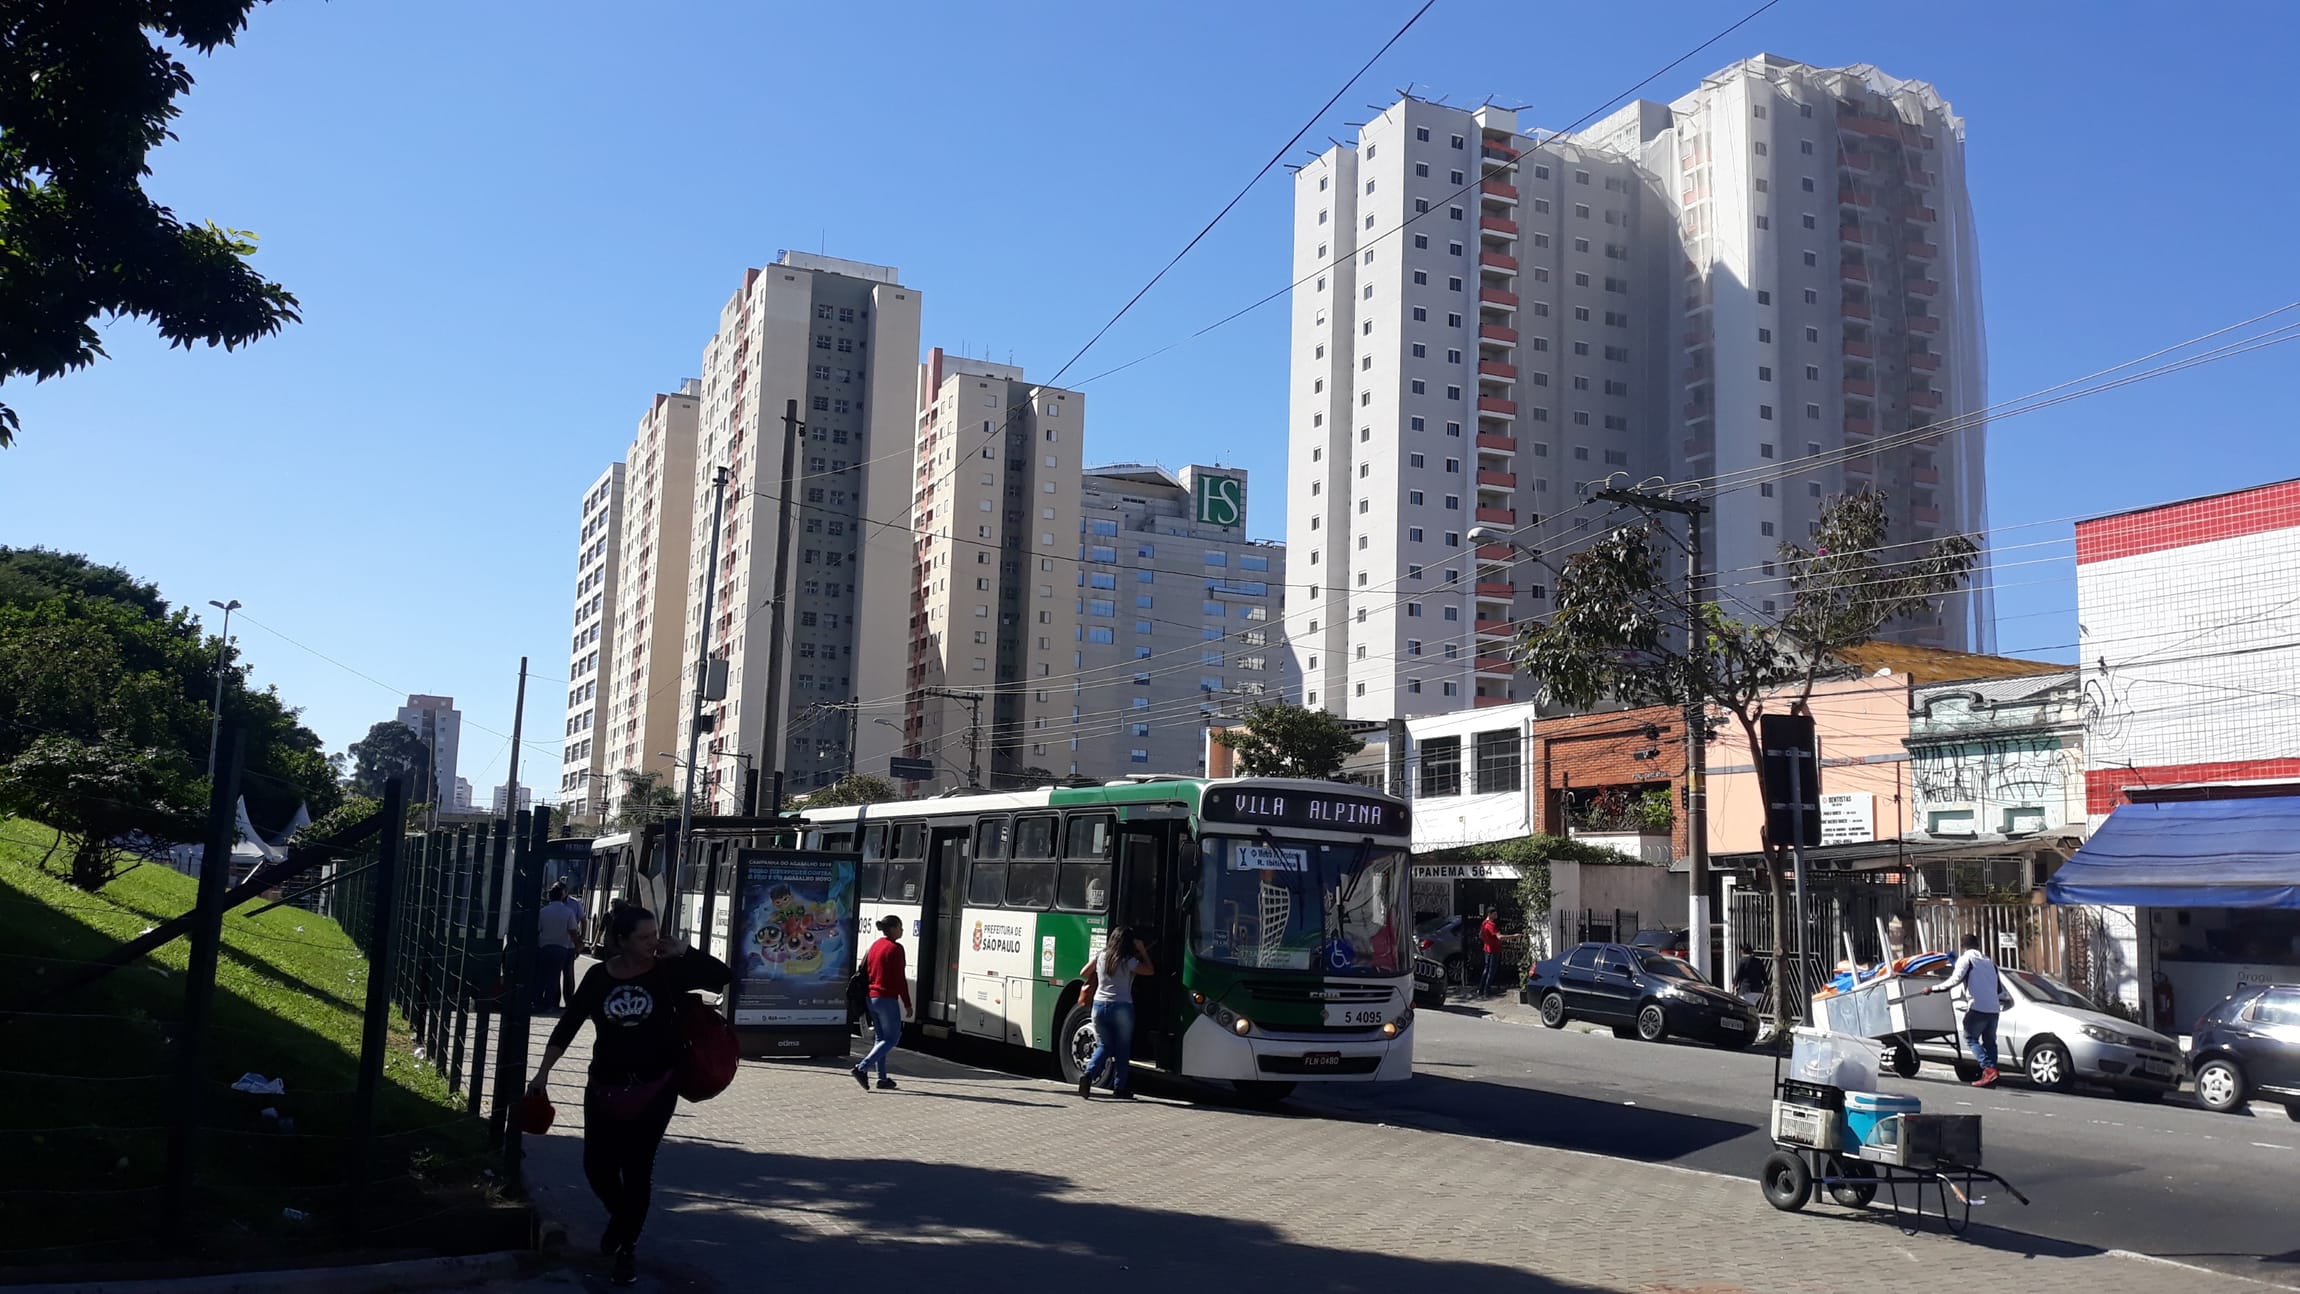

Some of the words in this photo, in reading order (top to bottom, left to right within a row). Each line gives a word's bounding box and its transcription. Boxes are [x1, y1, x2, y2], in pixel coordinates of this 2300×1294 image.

[1200, 476, 1239, 525] HS
[1235, 794, 1284, 816] VILA
[1309, 800, 1382, 825] ALPINA
[1414, 865, 1465, 878] IPANEMA
[984, 924, 1014, 936] PREFEITURA
[1014, 926, 1022, 937] DE
[982, 935, 996, 952] SÃO
[997, 939, 1021, 954] PAULO
[1344, 1011, 1352, 1023] 5
[1355, 1011, 1382, 1023] 4095
